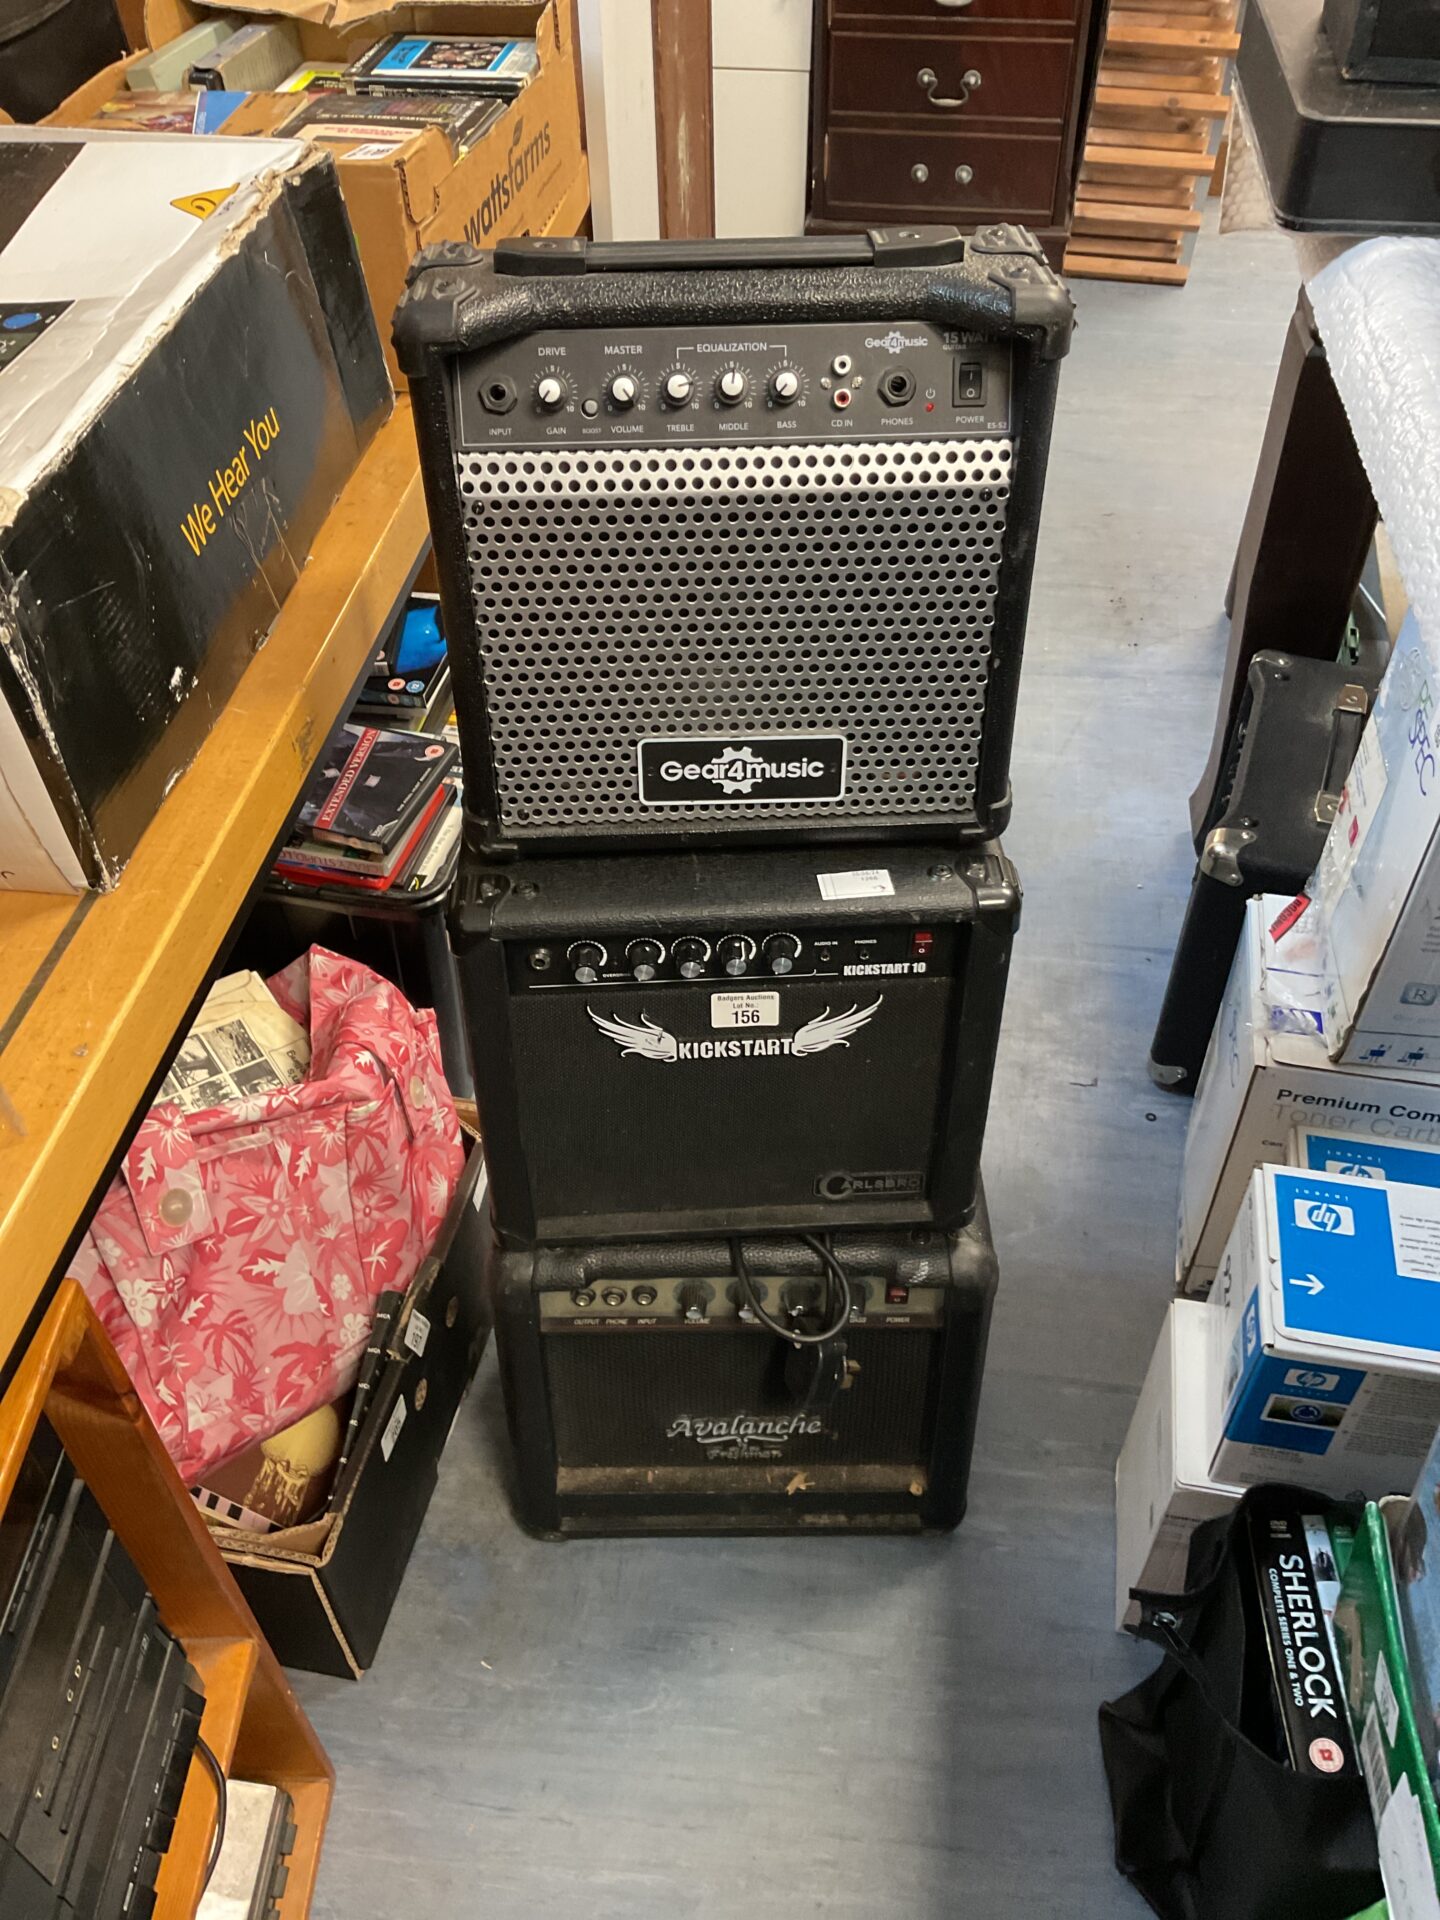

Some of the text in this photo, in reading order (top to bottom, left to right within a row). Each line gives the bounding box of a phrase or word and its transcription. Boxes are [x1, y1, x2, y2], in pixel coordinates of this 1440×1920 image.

[538, 347, 567, 356] DRIVE
[604, 345, 643, 355] MASTER
[696, 342, 768, 353] EQUALIZATION
[718, 422, 749, 431] MIDDLE
[776, 420, 797, 429] BASS
[831, 419, 853, 427] CD IN
[880, 417, 914, 426] PHONES
[955, 415, 985, 424] POWER
[488, 428, 512, 436] INPUT
[546, 427, 567, 435] GAIN
[610, 425, 644, 434] VOLUME
[666, 424, 695, 432] TREBLE
[180, 406, 280, 557] We Hear You
[321, 729, 377, 822] EXTENDED VERSION
[843, 962, 927, 977] KICKSTART 10
[731, 1010, 760, 1025] 156
[678, 1038, 794, 1060] KICKSTART
[1276, 1088, 1381, 1114] Premium
[1273, 1103, 1359, 1131] Toner
[666, 1414, 822, 1438] Avalanche
[1268, 1567, 1286, 1614] COMPLETE
[1277, 1616, 1292, 1646] SERIES
[1279, 1554, 1337, 1718] SHERLOCK
[1284, 1648, 1297, 1669] ONE
[1291, 1682, 1304, 1707] TWO
